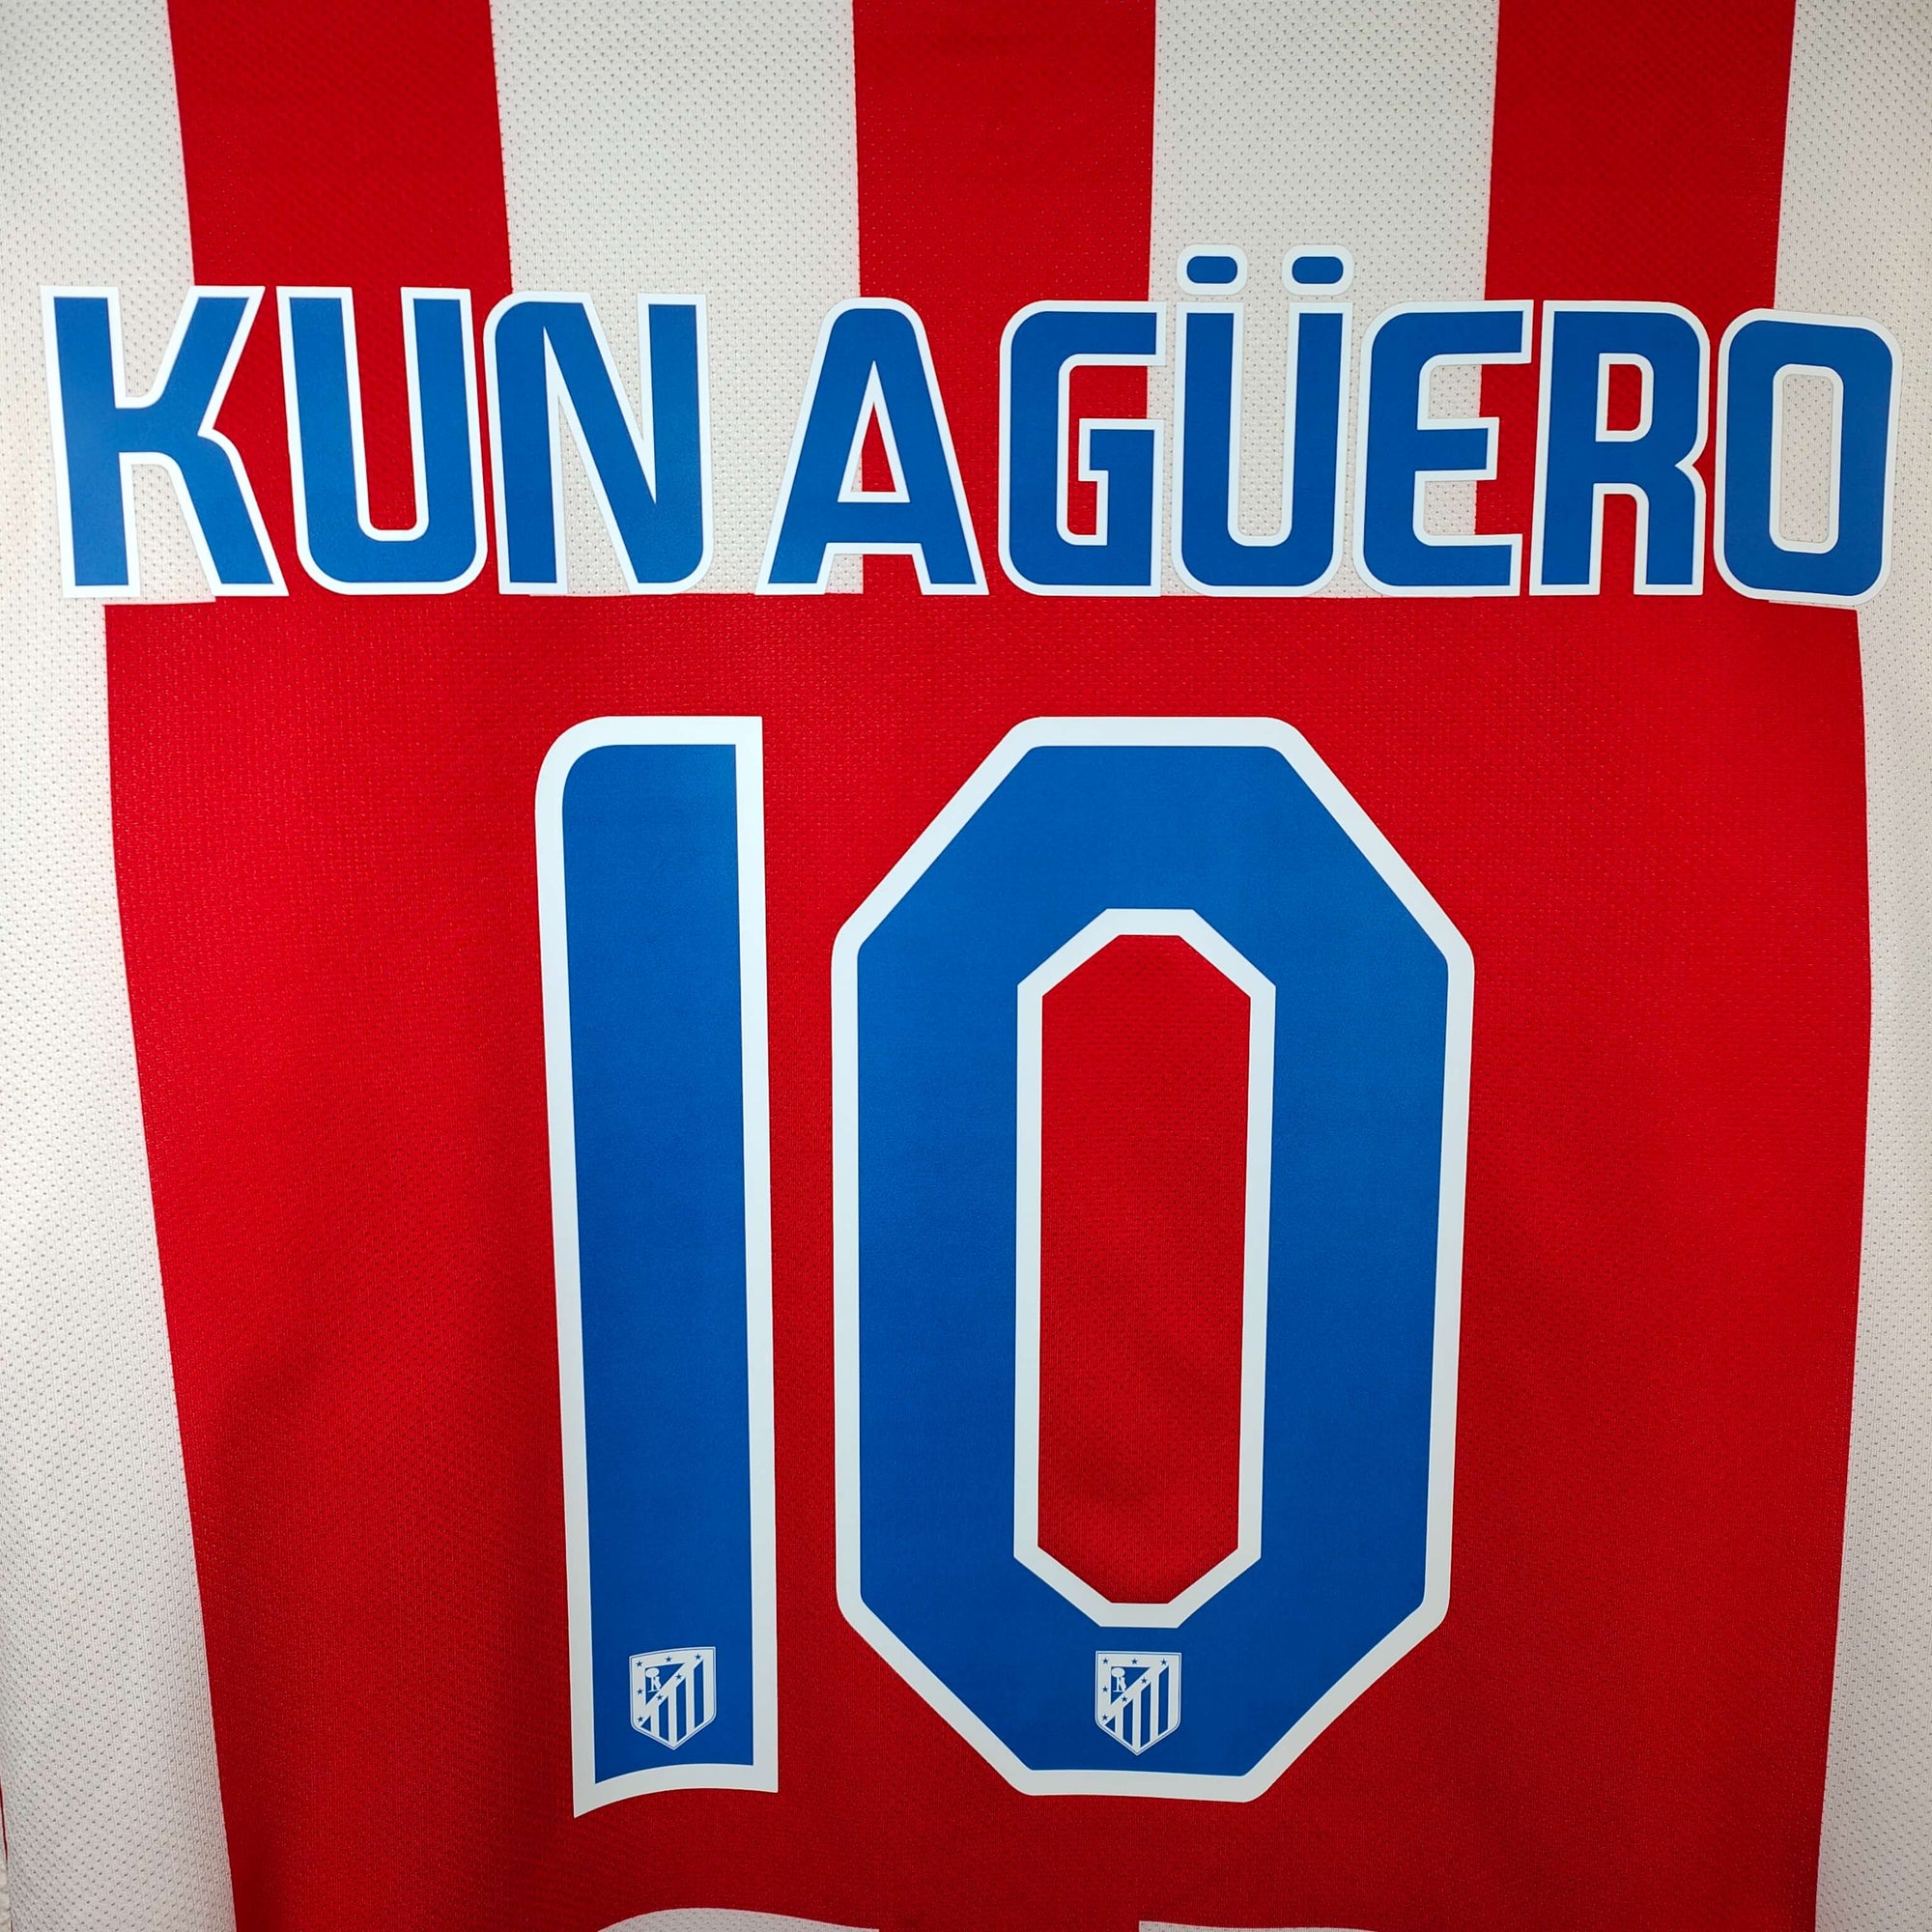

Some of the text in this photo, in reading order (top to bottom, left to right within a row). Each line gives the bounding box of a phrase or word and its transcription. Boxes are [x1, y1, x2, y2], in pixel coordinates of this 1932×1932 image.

[41, 243, 1902, 601] KUN AGÜERO
[534, 716, 1474, 1817] 10
